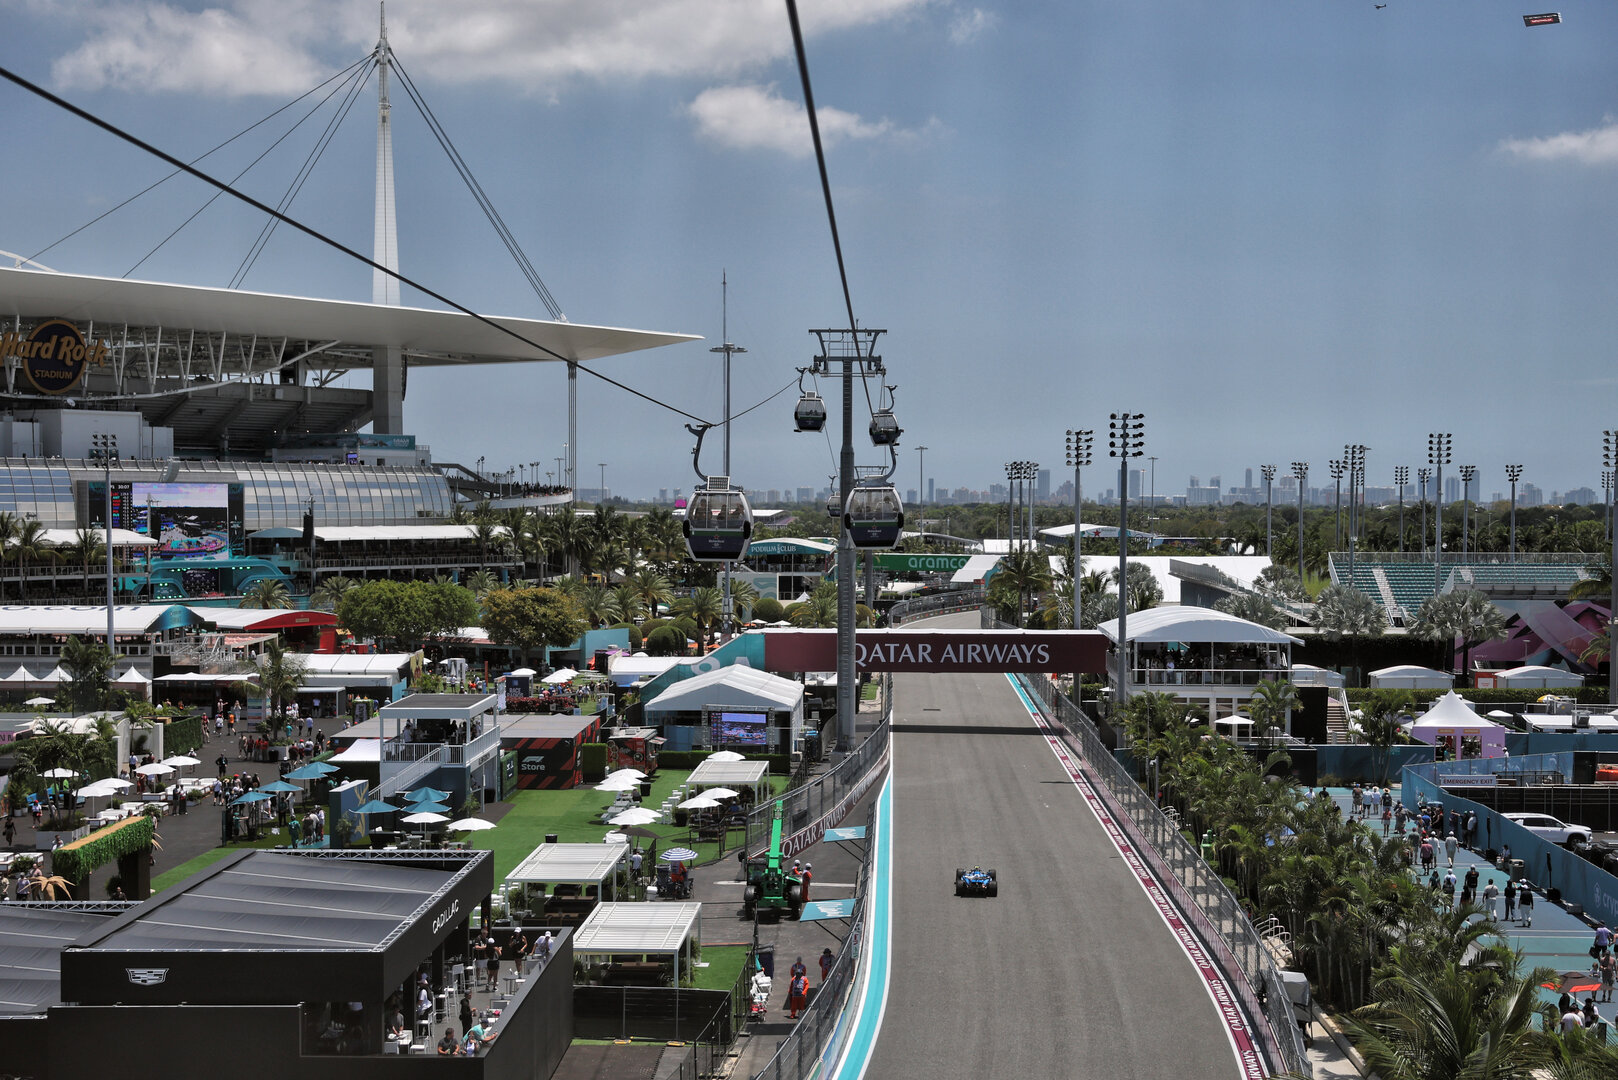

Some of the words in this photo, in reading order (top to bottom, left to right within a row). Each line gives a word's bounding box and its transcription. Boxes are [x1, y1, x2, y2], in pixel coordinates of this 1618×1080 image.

[0, 332, 57, 363] Hard
[57, 336, 109, 367] Rock
[34, 370, 73, 380] STADIUM
[908, 556, 968, 569] aramco
[855, 643, 933, 668] QATAR
[940, 643, 1051, 664] AIRWAYS
[521, 763, 546, 771] Store
[782, 825, 818, 859] QATAR
[818, 802, 847, 837] AIRWAYS
[432, 898, 459, 934] CADILLAC
[1211, 979, 1233, 1007] AIRWAYS
[1222, 1006, 1245, 1031] QATAR
